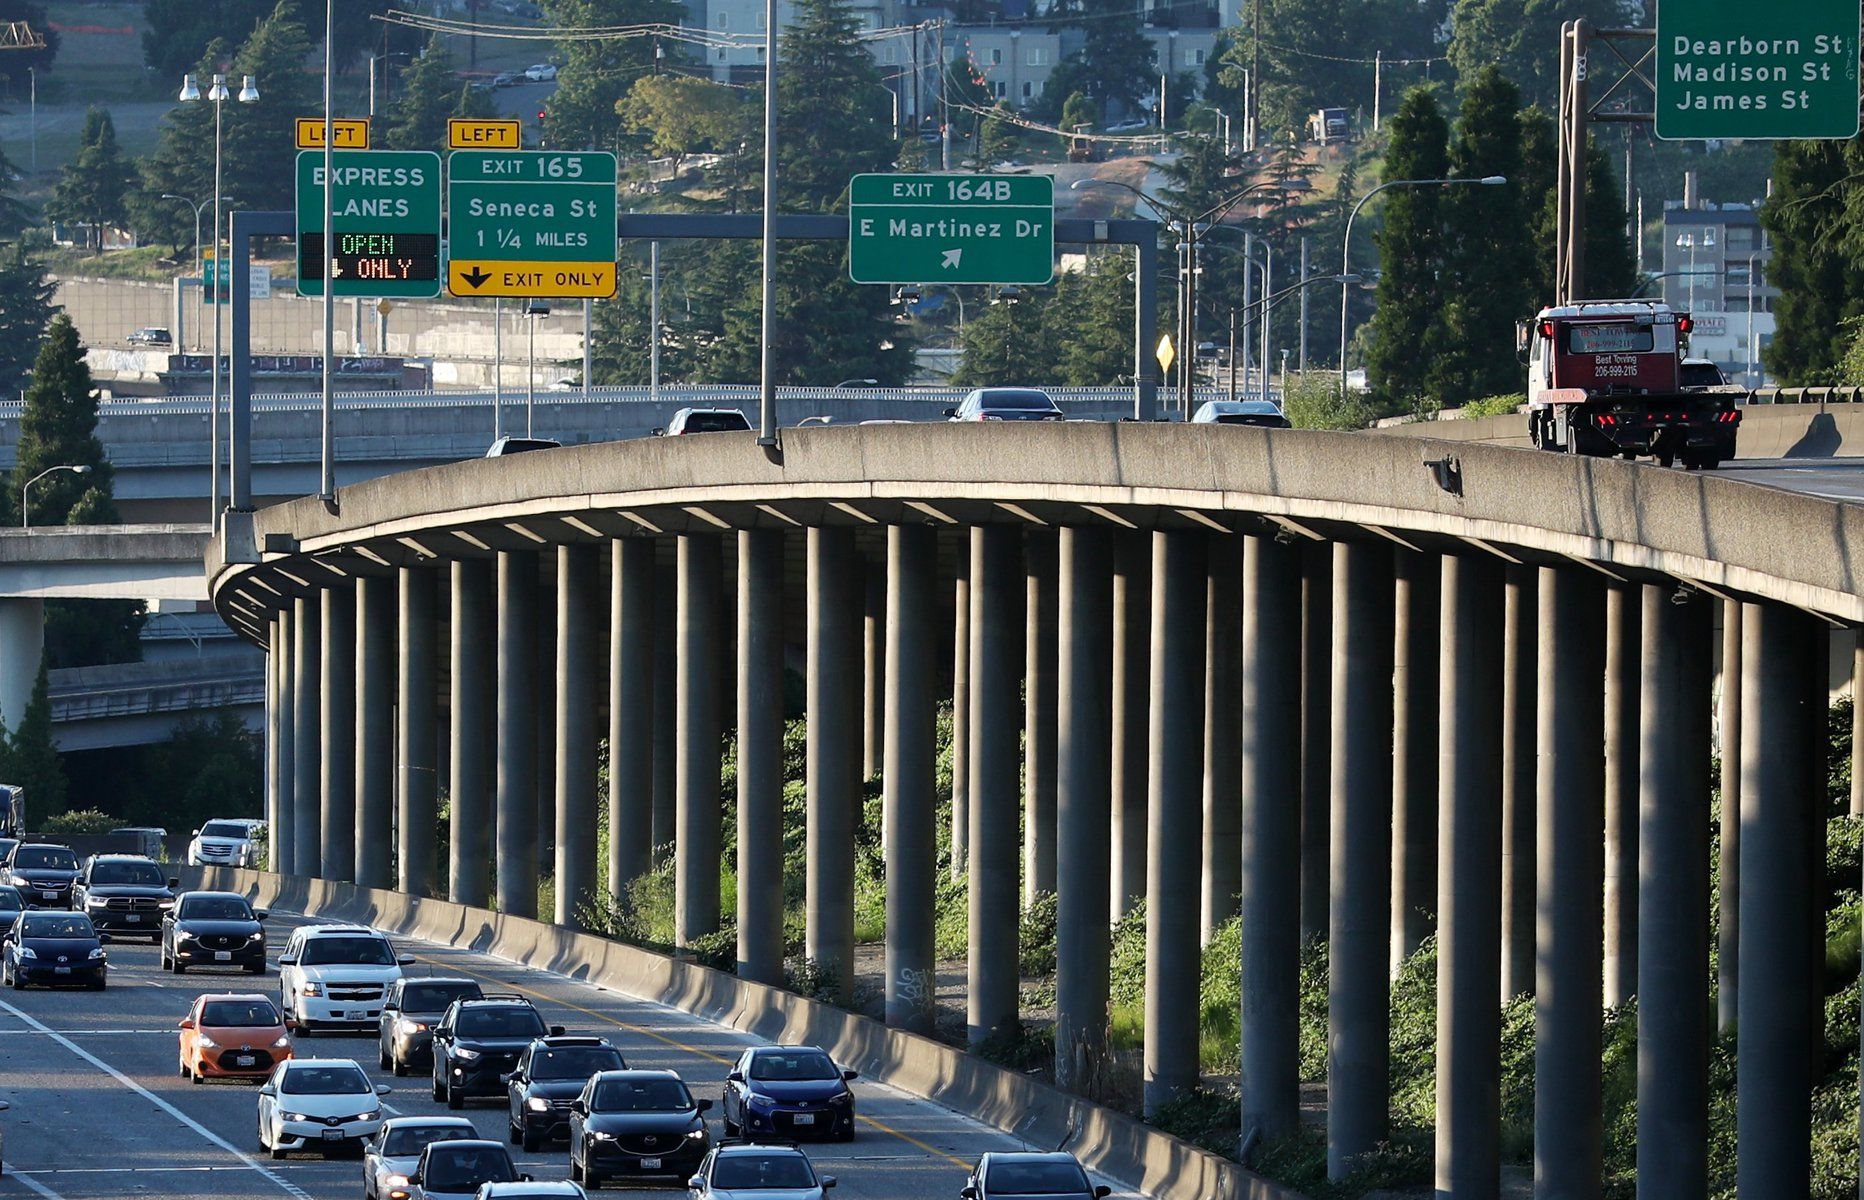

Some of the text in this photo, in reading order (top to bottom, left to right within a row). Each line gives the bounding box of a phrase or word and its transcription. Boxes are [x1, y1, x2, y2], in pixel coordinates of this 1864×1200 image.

[1674, 34, 1842, 55] Dearborn St
[1673, 62, 1831, 82] Madison St
[1676, 90, 1809, 110] James St
[461, 128, 507, 141] LEFT
[313, 167, 425, 186] EXPRESS
[482, 157, 583, 178] EXIT 165
[892, 180, 1012, 201] EXIT 164B
[469, 198, 597, 218] Seneca St
[477, 229, 484, 247] 1
[535, 232, 588, 247] MILES
[860, 218, 1043, 238] E Martinez Dr
[342, 234, 394, 255] OPEN
[358, 258, 413, 279] ONLY
[503, 272, 604, 287] EXIT ONLY
[1595, 354, 1637, 365] Best Towing
